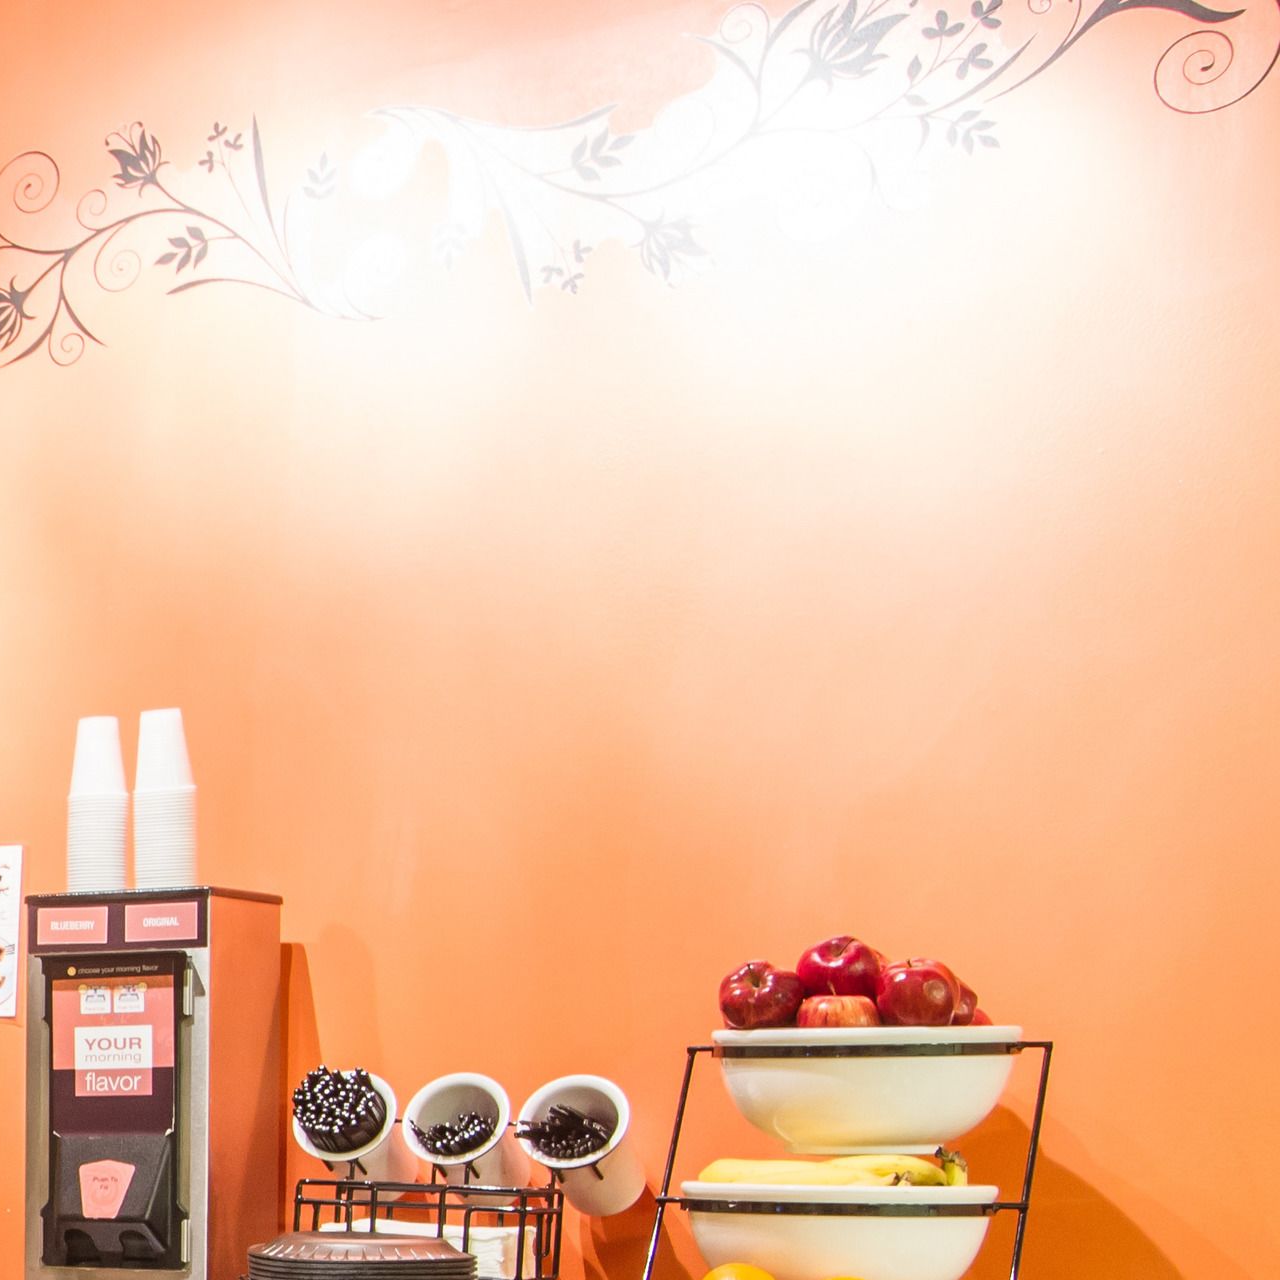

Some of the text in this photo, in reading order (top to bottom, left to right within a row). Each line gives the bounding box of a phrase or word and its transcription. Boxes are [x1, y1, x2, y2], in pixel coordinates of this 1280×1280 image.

[50, 920, 95, 931] BLUEBERRY
[142, 917, 179, 928] ORIGINAL
[84, 1037, 142, 1051] YOUR
[84, 1052, 142, 1063] morning
[85, 1072, 142, 1091] flavor
